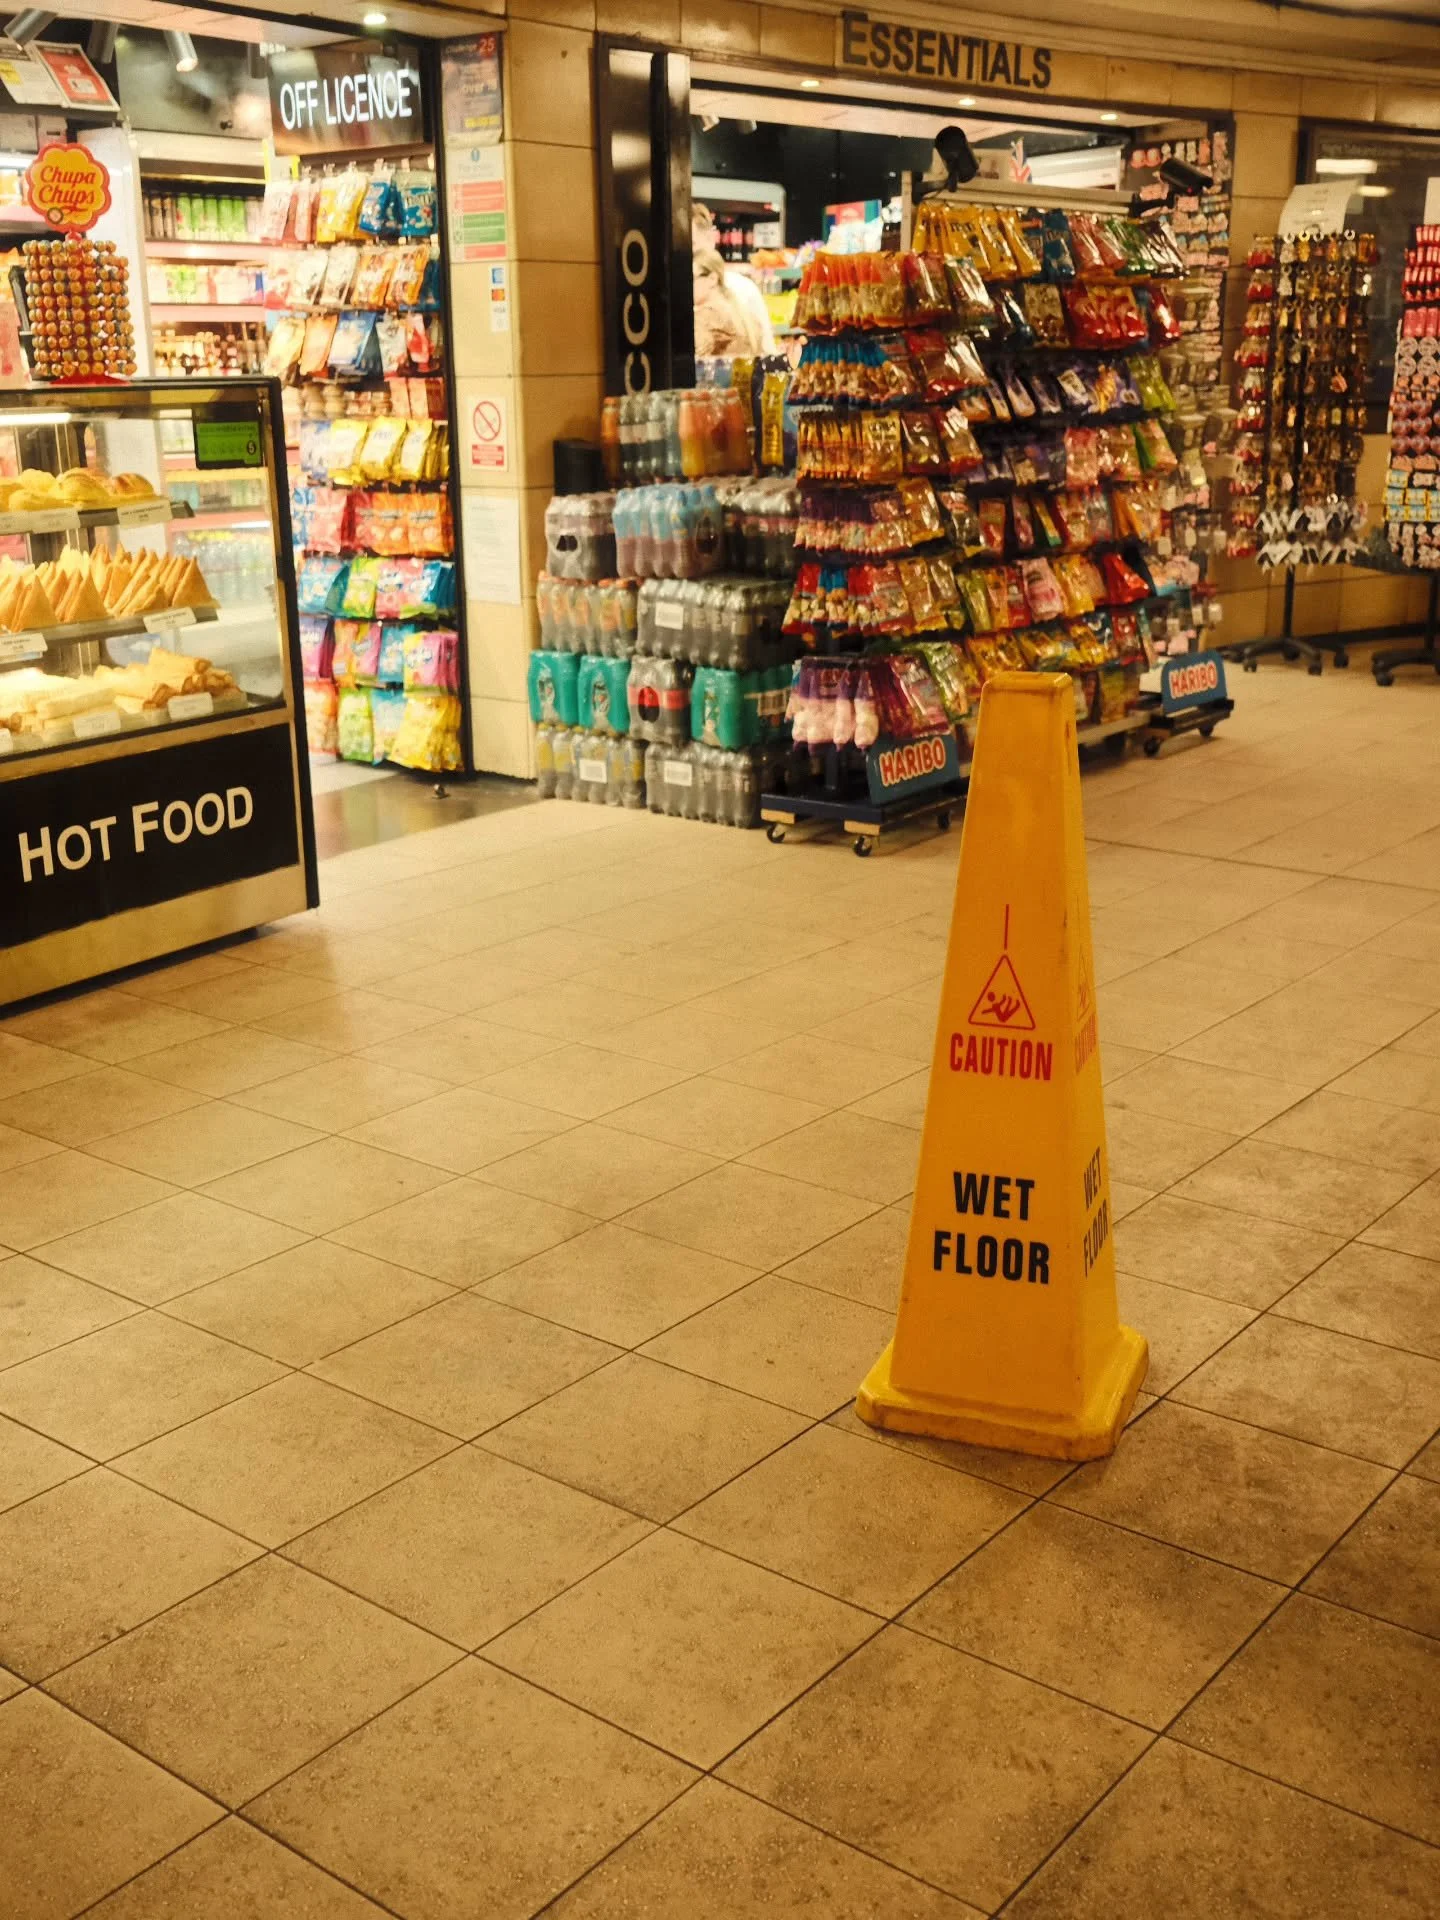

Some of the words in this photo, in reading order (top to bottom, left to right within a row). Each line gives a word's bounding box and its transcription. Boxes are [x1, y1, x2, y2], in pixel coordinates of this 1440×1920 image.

[842, 10, 1052, 89] ESSENTIALS
[280, 79, 318, 130] OFF
[323, 69, 412, 125] LICENCE
[38, 184, 96, 209] Chups
[39, 165, 96, 188] Chupa
[1168, 660, 1218, 699] HARIBO
[879, 737, 945, 787] HARIBO
[18, 816, 117, 883] HOT
[132, 786, 253, 853] FOOD
[950, 1032, 1053, 1081] CAUTION
[953, 1171, 1035, 1221] WET
[1083, 1146, 1102, 1212] WET
[933, 1229, 1050, 1285] FLOOR
[1083, 1198, 1109, 1279] FLOOR
